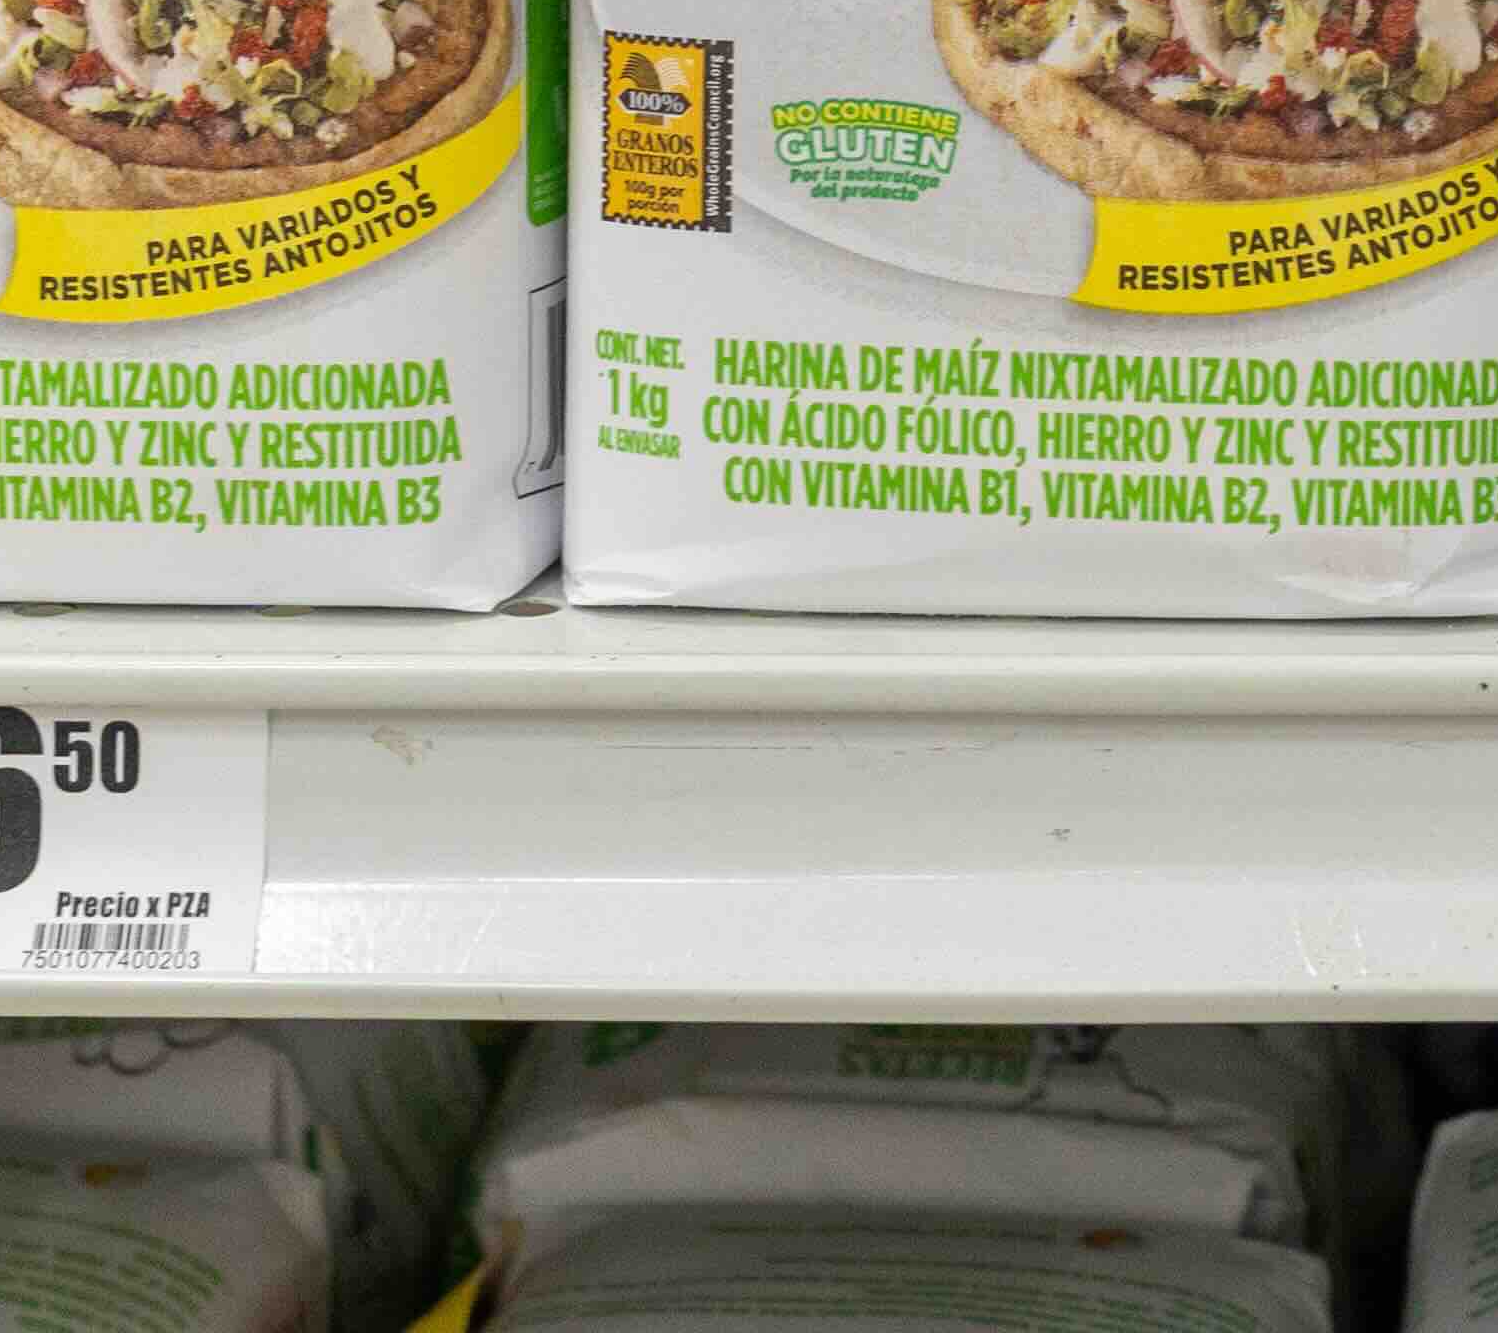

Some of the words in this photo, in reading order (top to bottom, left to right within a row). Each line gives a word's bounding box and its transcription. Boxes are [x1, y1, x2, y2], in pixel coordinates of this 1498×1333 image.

[627, 89, 684, 114] 100%
[773, 103, 818, 128] NO
[821, 100, 959, 133] CONTIENE
[615, 129, 695, 156] GRANOS
[705, 53, 726, 217] WholeGrainsCouncil.org
[776, 128, 957, 172] GLUTEN
[613, 150, 699, 179] ENTEROS
[147, 235, 229, 266] PARA
[237, 180, 396, 250] VARIADOS
[399, 164, 421, 191] Y
[40, 259, 252, 301] RESISTENTES
[264, 193, 438, 277] ANTOJITOS
[56, 892, 138, 918] Precio
[145, 897, 159, 918] x
[166, 892, 211, 918] PZA
[21, 950, 200, 970] 7501077400203
